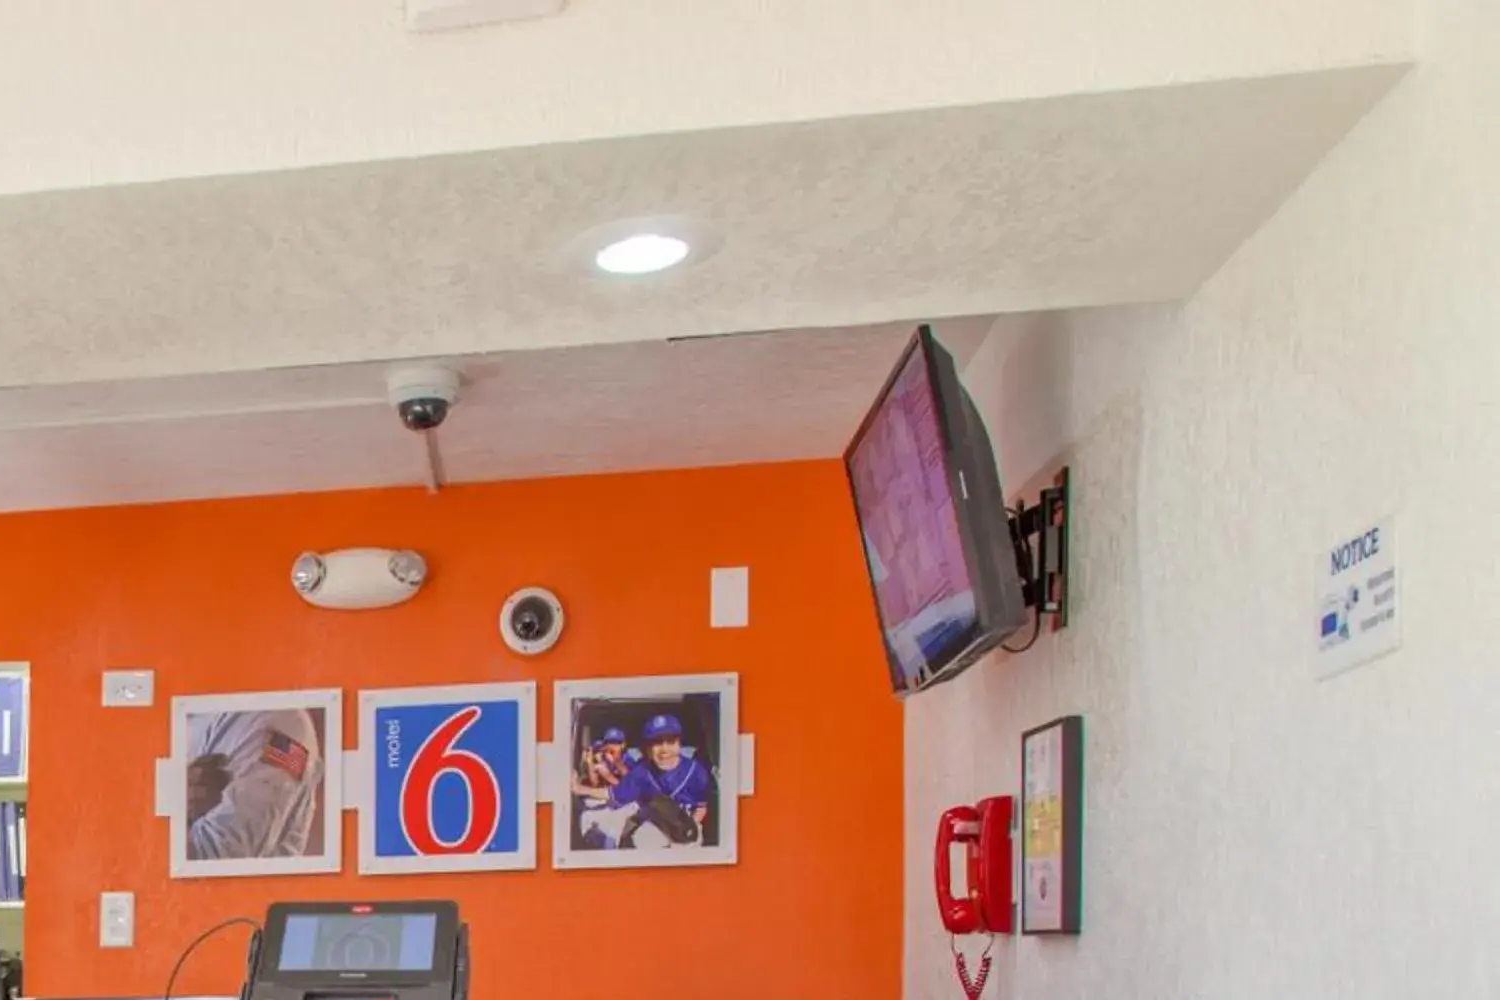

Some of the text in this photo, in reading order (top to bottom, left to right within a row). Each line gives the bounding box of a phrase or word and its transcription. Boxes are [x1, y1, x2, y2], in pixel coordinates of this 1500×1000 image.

[1330, 527, 1380, 576] NOTICE
[385, 718, 401, 769] motel
[399, 705, 501, 857] 6
